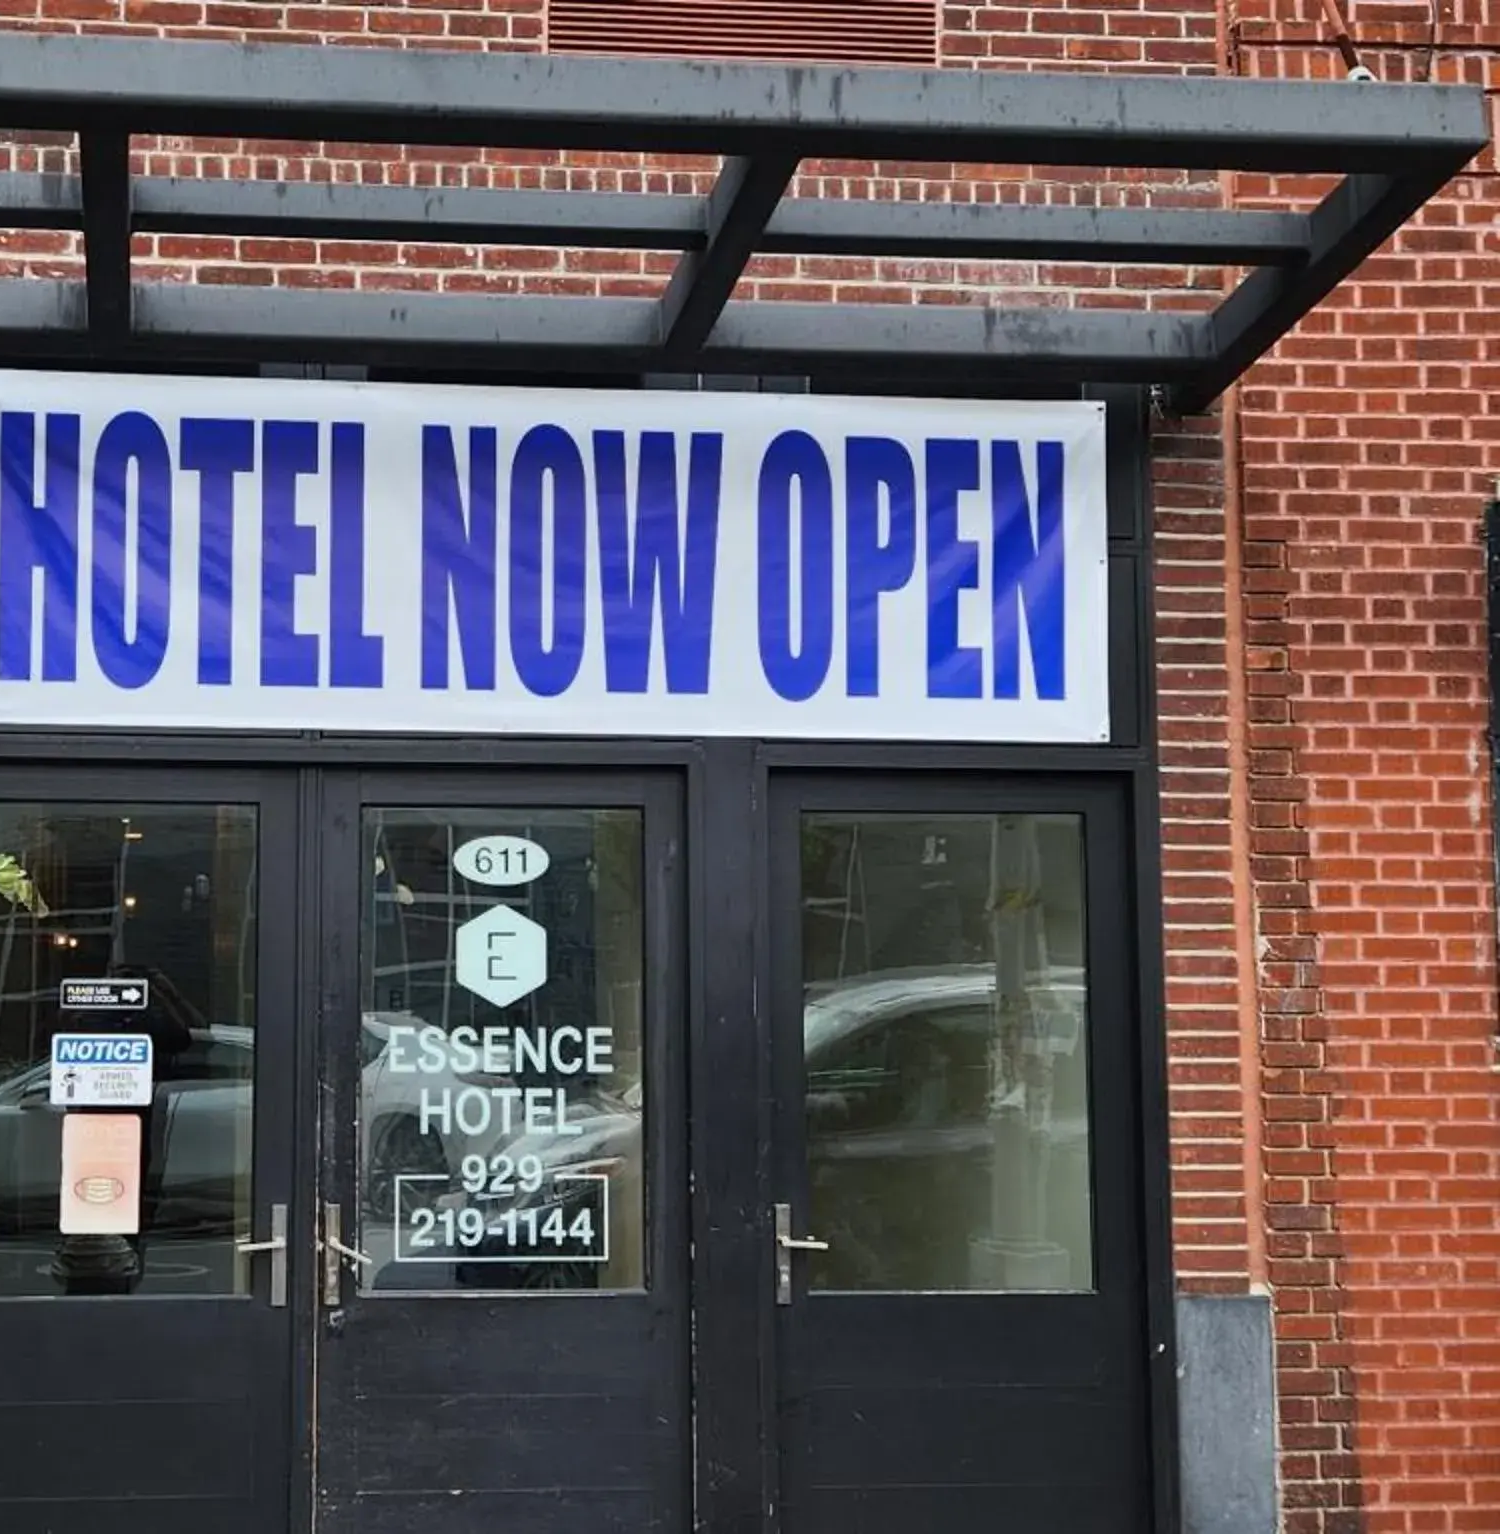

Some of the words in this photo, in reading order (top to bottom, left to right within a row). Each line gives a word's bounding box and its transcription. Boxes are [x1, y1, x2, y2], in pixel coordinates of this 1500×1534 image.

[420, 423, 724, 698] NOW
[757, 429, 1066, 703] OPEN
[474, 846, 530, 875] 611
[487, 931, 517, 981] E
[59, 1041, 147, 1061] NOTICE
[388, 1026, 614, 1074] ESSENCE
[419, 1087, 584, 1136] HOTEL
[460, 1154, 545, 1194] 929
[408, 1207, 596, 1248] 219-1144
